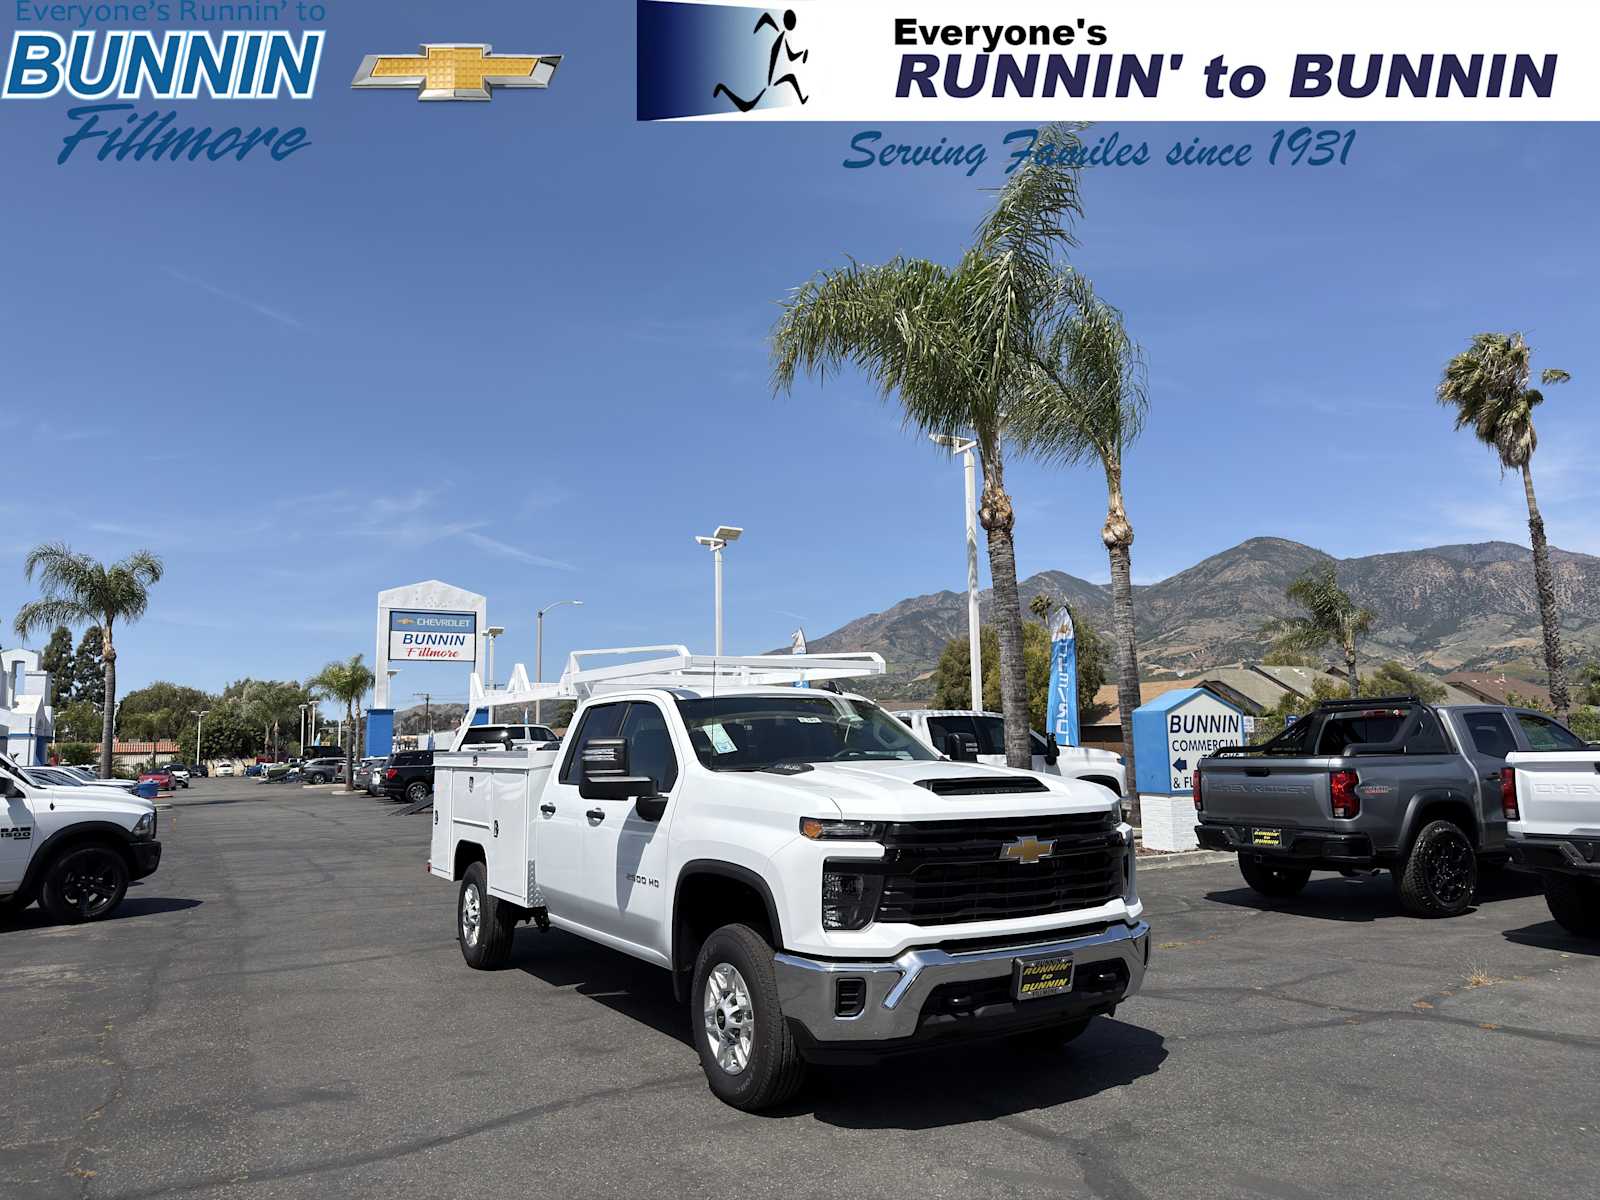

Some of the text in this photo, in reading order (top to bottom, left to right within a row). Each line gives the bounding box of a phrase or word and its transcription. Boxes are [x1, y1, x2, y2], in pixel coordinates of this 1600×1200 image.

[416, 617, 469, 627] CHEVROLET
[403, 633, 466, 646] BUNNIN
[407, 647, 460, 658] Fillmore
[1170, 714, 1239, 734] BUNNIN
[1173, 777, 1181, 788] &
[1021, 978, 1069, 993] BUNNIN
